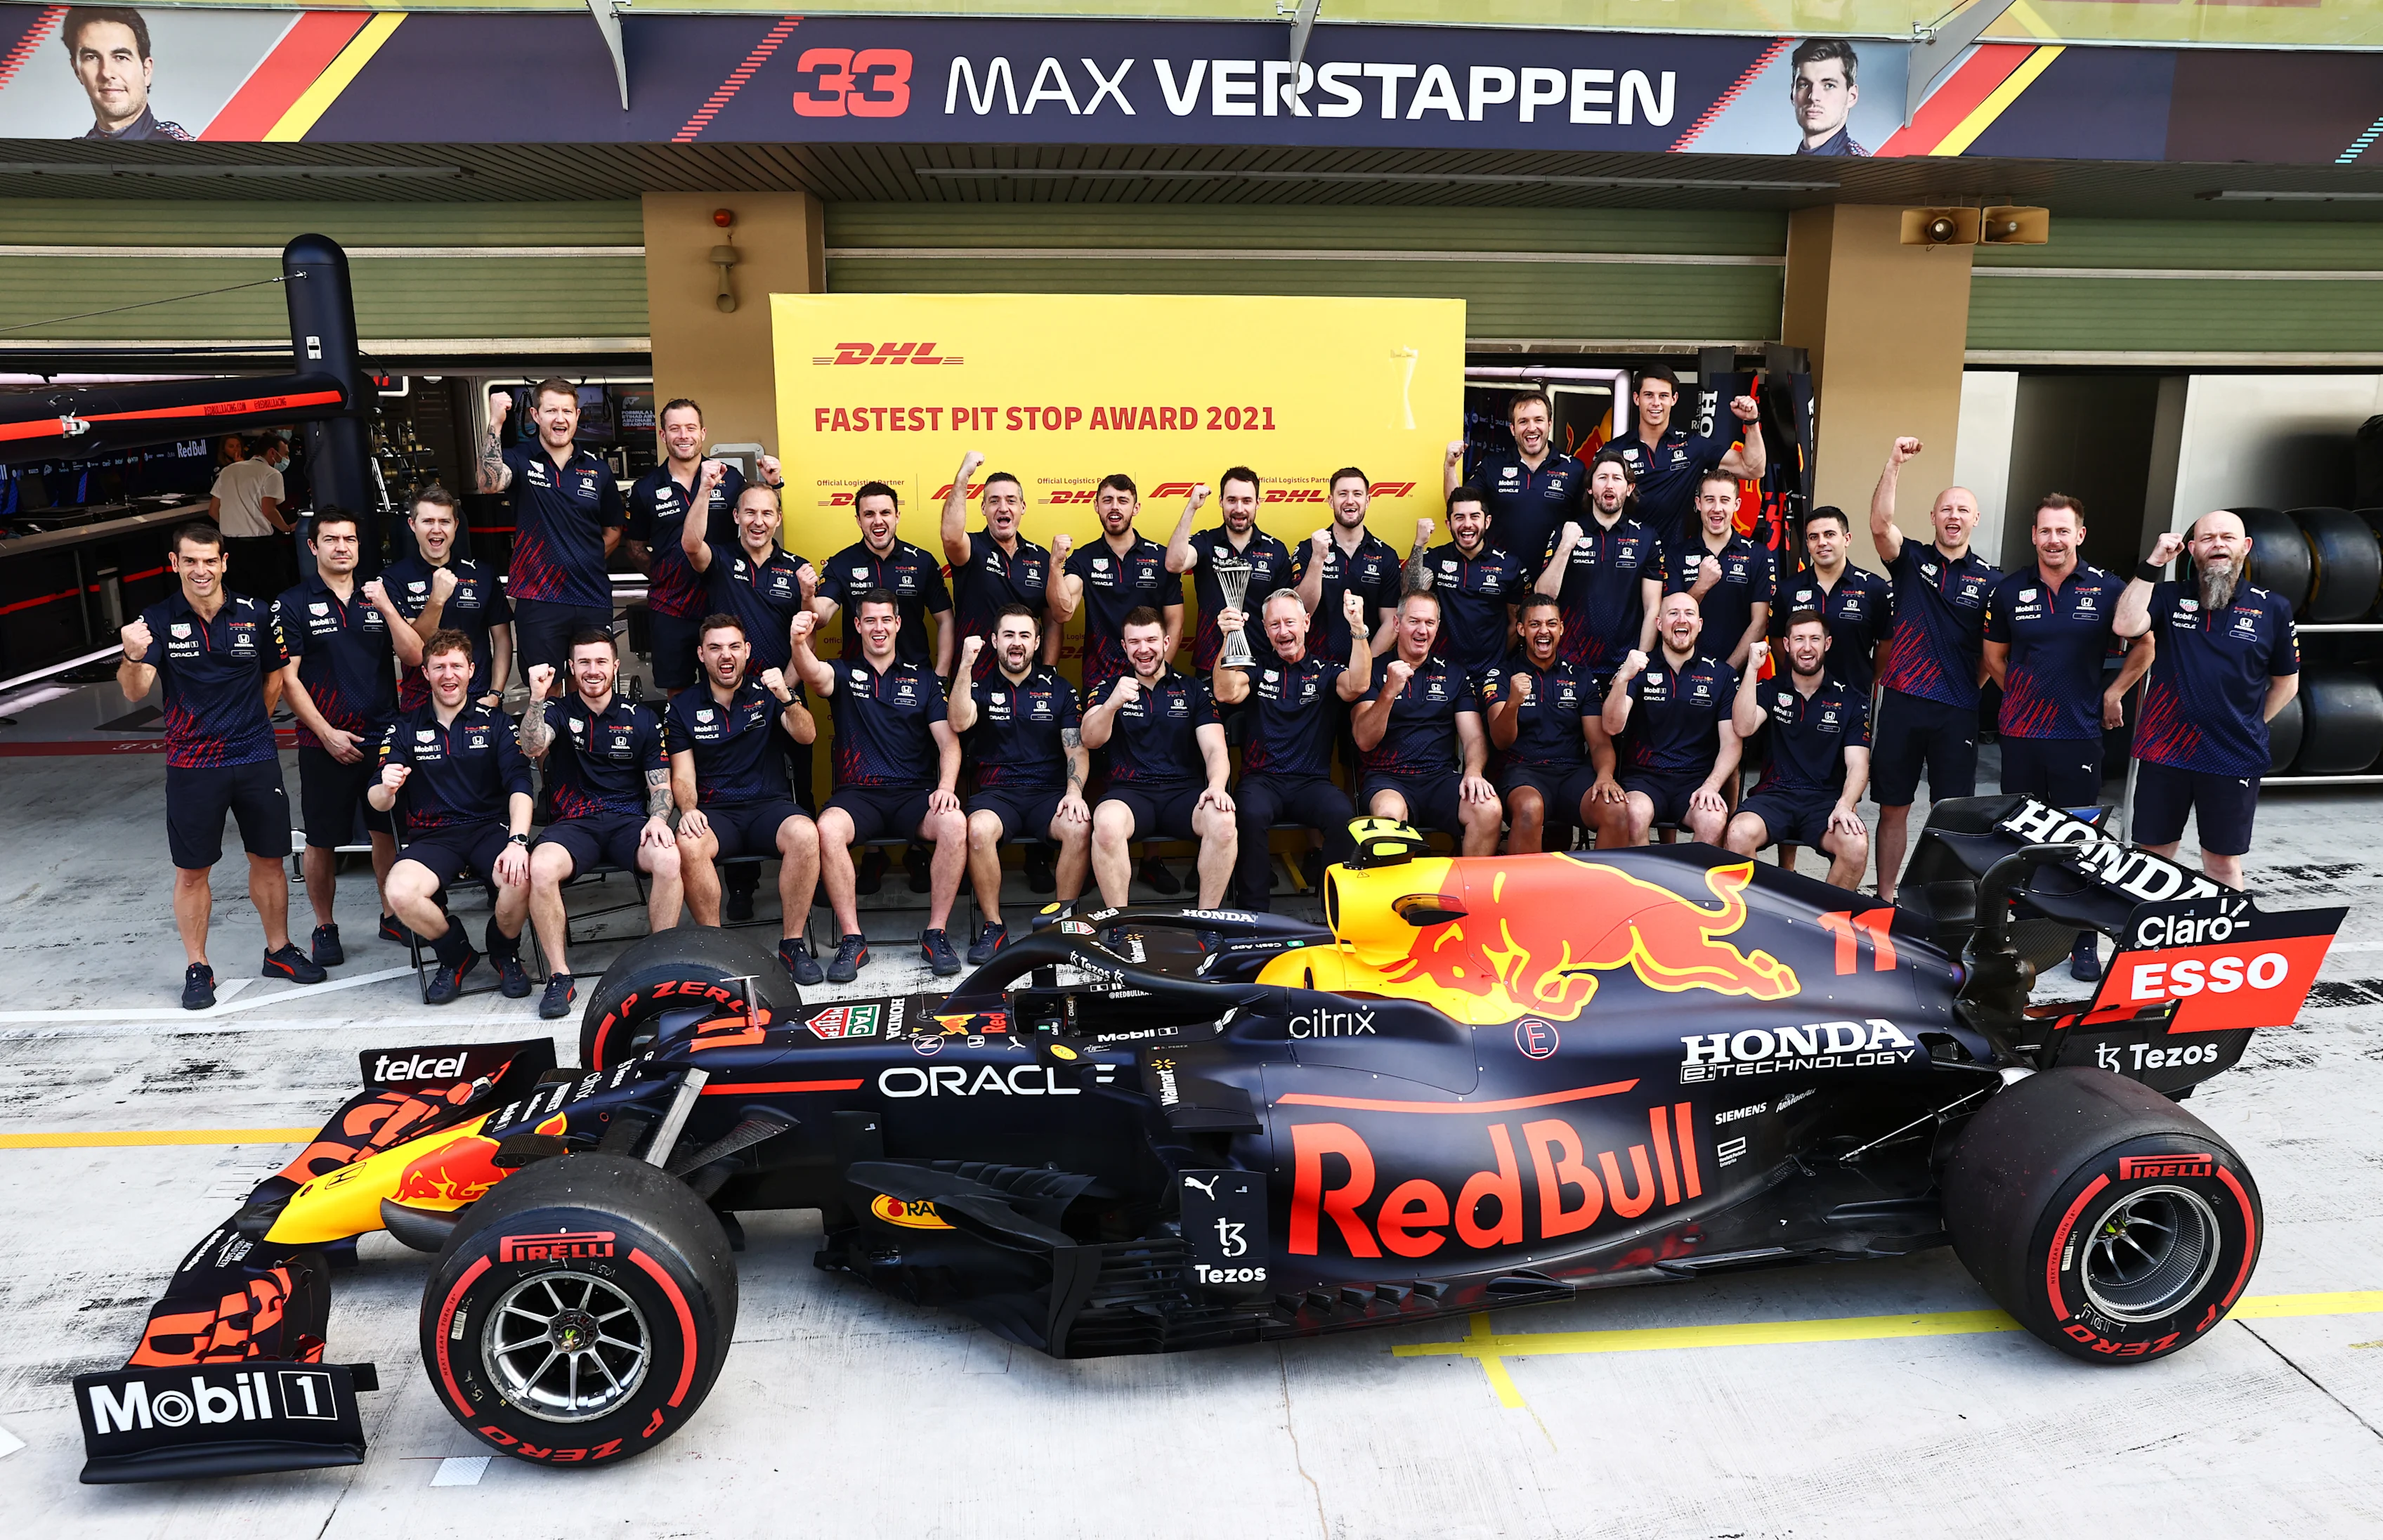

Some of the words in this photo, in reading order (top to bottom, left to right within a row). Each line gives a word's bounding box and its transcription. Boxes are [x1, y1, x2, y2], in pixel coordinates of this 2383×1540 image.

[793, 48, 913, 117] 33
[944, 56, 1136, 116] MAX
[1153, 59, 1677, 126] VERSTAPPEN
[834, 343, 944, 365] DHL
[815, 407, 944, 432] FASTEST
[951, 407, 1000, 431] PIT
[1006, 407, 1083, 431] STOP
[1090, 407, 1199, 431] AWARD
[1206, 406, 1275, 430] 2021
[1050, 491, 1097, 504] DH
[1265, 490, 1326, 502] DHL
[312, 627, 338, 635] ORACLE
[2002, 799, 2219, 901] HONDA
[1088, 908, 1119, 921] telcel
[1182, 909, 1255, 922] HONDA
[1817, 907, 1896, 975] 11
[1080, 957, 1110, 979] Tezos
[2131, 952, 2288, 1000] ESSO
[620, 993, 638, 1018] P
[885, 998, 905, 1040] HONDA
[851, 1007, 875, 1036] TAG
[1288, 1006, 1376, 1038] citrix
[1097, 1029, 1155, 1042] Mobil
[1680, 1019, 1915, 1066] HONDA
[373, 1052, 468, 1081] telcel
[2129, 1043, 2218, 1069] Tezos
[1161, 1069, 1180, 1106] Walmart
[1715, 1102, 1767, 1125] SIEMENS
[2119, 1153, 2212, 1180] PIRELLI
[2058, 1222, 2069, 1241] TURN
[500, 1232, 615, 1262] PIRELLI
[1195, 1264, 1266, 1284] Tezos
[442, 1308, 451, 1326] TURN
[2063, 1324, 2180, 1357] ZERO
[89, 1371, 273, 1434] Mobil
[642, 1408, 664, 1438] P
[478, 1425, 622, 1461] ZERO
